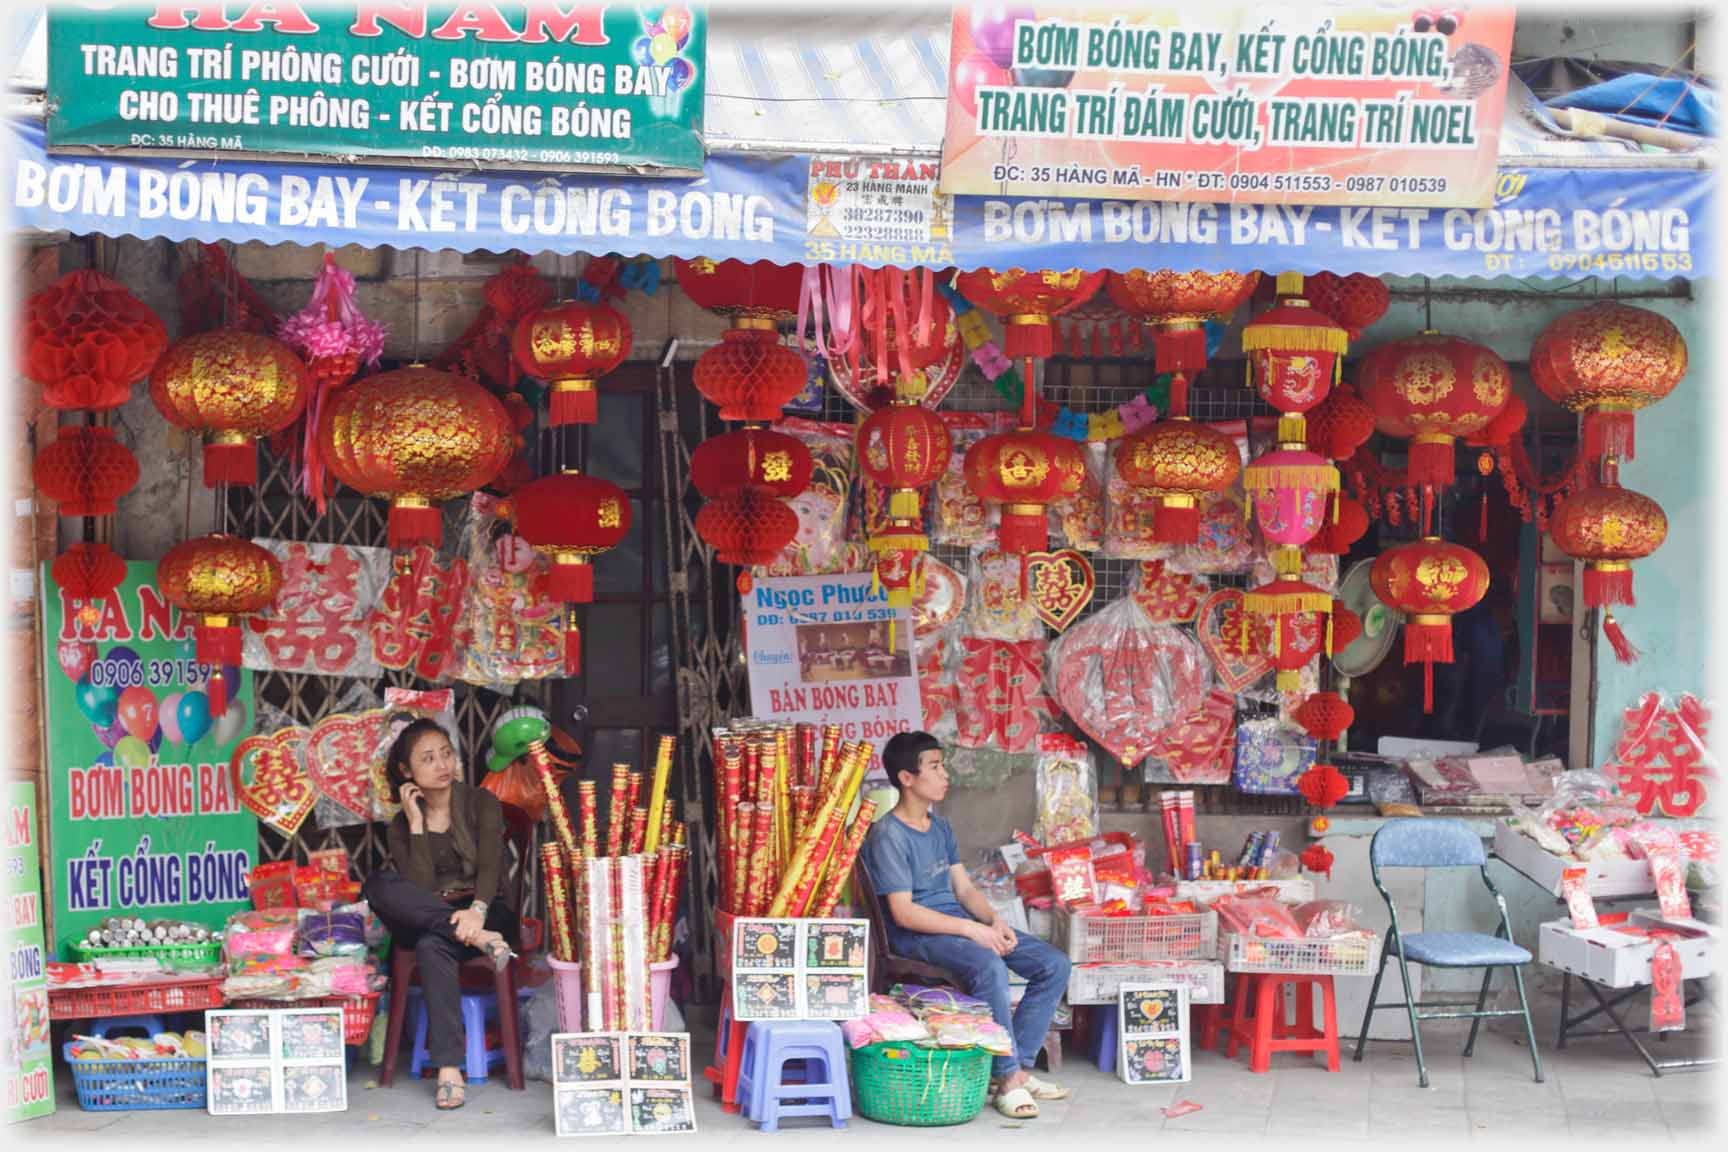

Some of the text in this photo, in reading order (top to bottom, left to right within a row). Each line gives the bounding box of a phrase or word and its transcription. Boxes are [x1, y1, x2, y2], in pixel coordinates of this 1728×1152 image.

[81, 45, 177, 78] TRANG
[187, 43, 233, 80] TRÍ
[241, 45, 341, 84] PHÔNG
[351, 48, 419, 87] CƯỚI
[450, 56, 515, 91] BƠM
[525, 57, 605, 95] BÓNG
[615, 65, 672, 97] BAY
[1018, 19, 1449, 80] BƠM BÓNG BAY, KẾT CỔNG BÓNG,
[119, 90, 178, 121] CHO
[187, 88, 260, 124] THUÊ
[270, 91, 369, 128] PHÔNG
[400, 90, 453, 132] KẾT
[462, 93, 541, 135] CỔNG
[551, 102, 631, 139] BÓNG
[980, 88, 1475, 144] TRANG TRÍ ĐÁM CƯỚI, TRANG TRÍ NOEL
[159, 135, 174, 147] 35
[15, 159, 127, 216] BƠM
[138, 160, 270, 225] BÓNG
[279, 175, 370, 229] BAY
[994, 166, 1025, 181] ĐC:
[1031, 167, 1050, 182] 35
[1056, 163, 1107, 185] HÀNG
[1113, 165, 1140, 185] MÃ
[1156, 173, 1180, 187] HN
[1198, 174, 1225, 188] ĐT:
[1230, 175, 1269, 190] 0904
[1274, 176, 1330, 191] 511553
[1346, 177, 1384, 192] 0987
[1389, 178, 1446, 193] 010539
[1230, 204, 1315, 246] BAY
[1572, 198, 1690, 251] BÓNG
[92, 661, 143, 686] 0906
[863, 682, 898, 708] BAY
[70, 763, 123, 818] BƠM
[130, 754, 192, 816] BÓNG
[69, 836, 249, 909] KẾT CỔNG BÓNG
